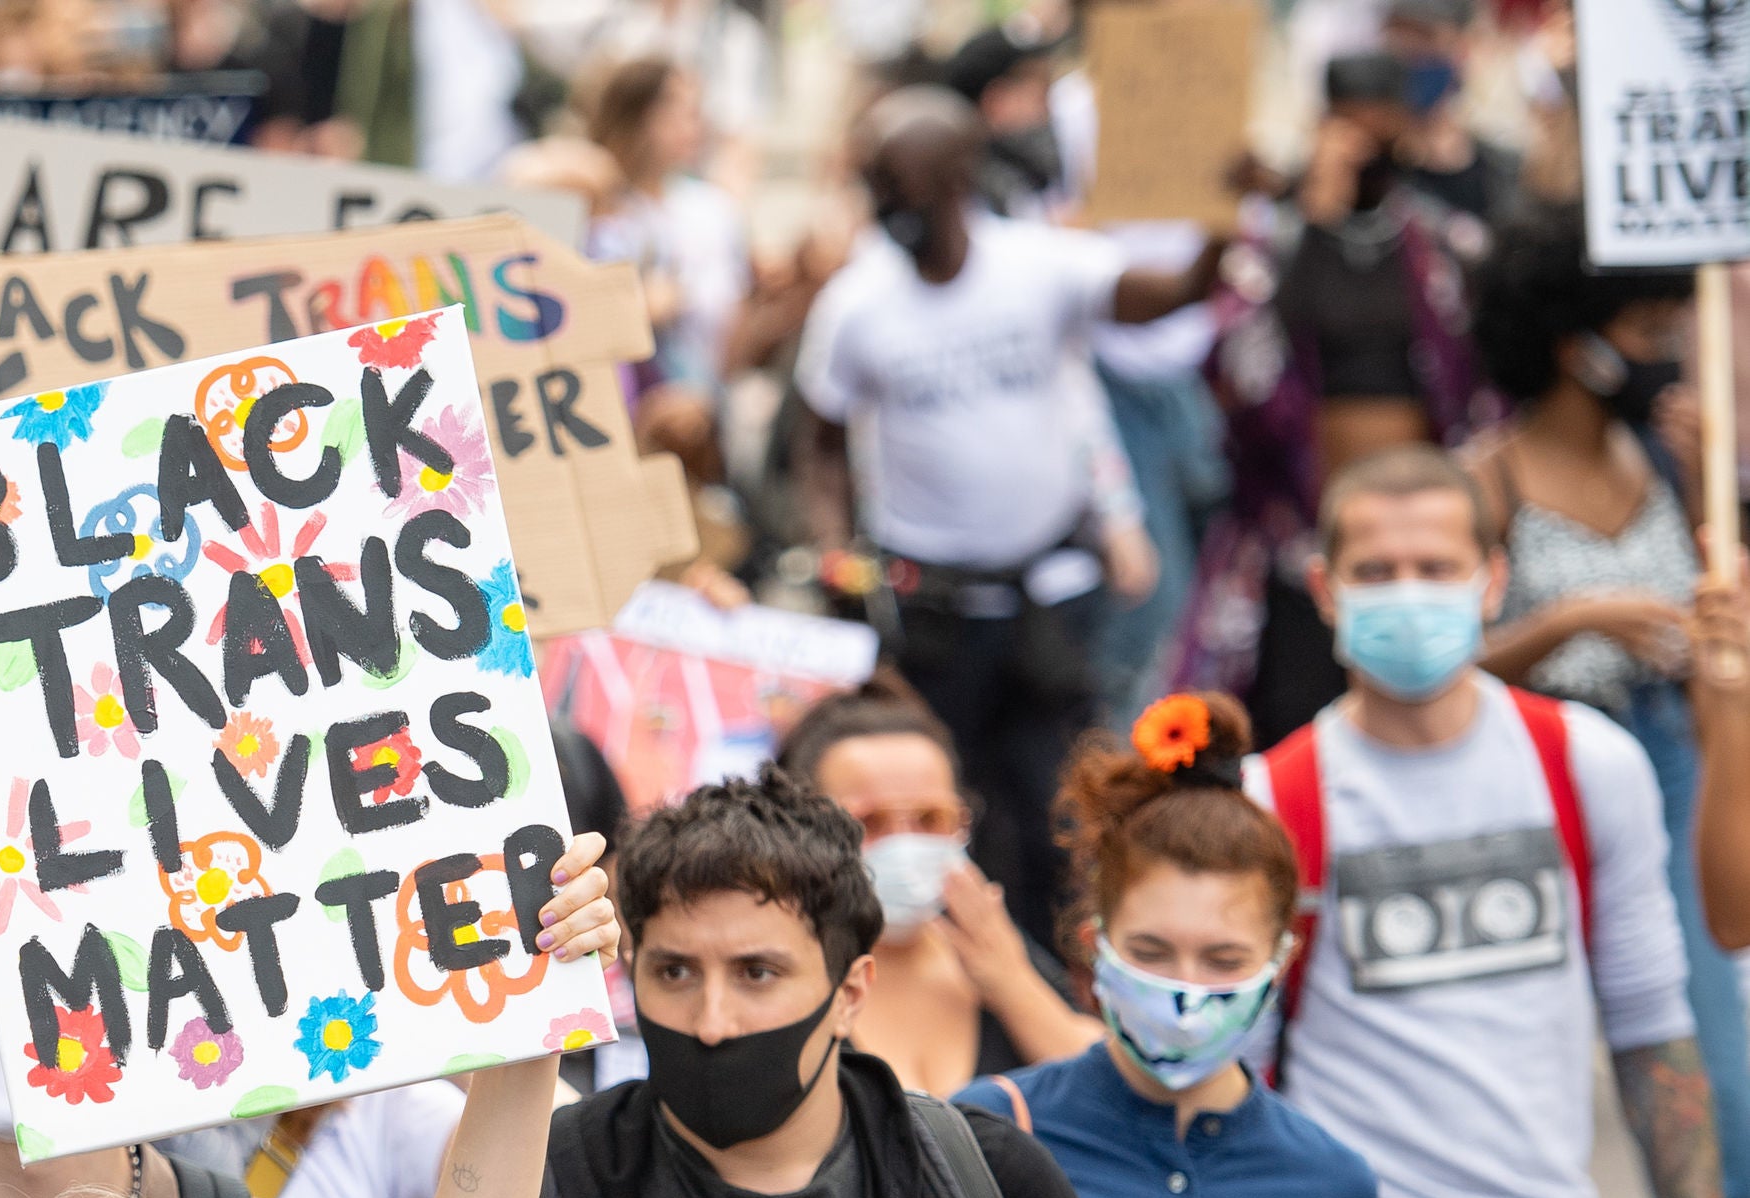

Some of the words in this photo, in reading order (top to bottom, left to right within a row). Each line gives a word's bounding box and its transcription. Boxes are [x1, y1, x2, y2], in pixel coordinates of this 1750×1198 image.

[231, 252, 564, 344] TRANS
[28, 691, 510, 893] LIVES
[18, 824, 567, 1068] MATTER
